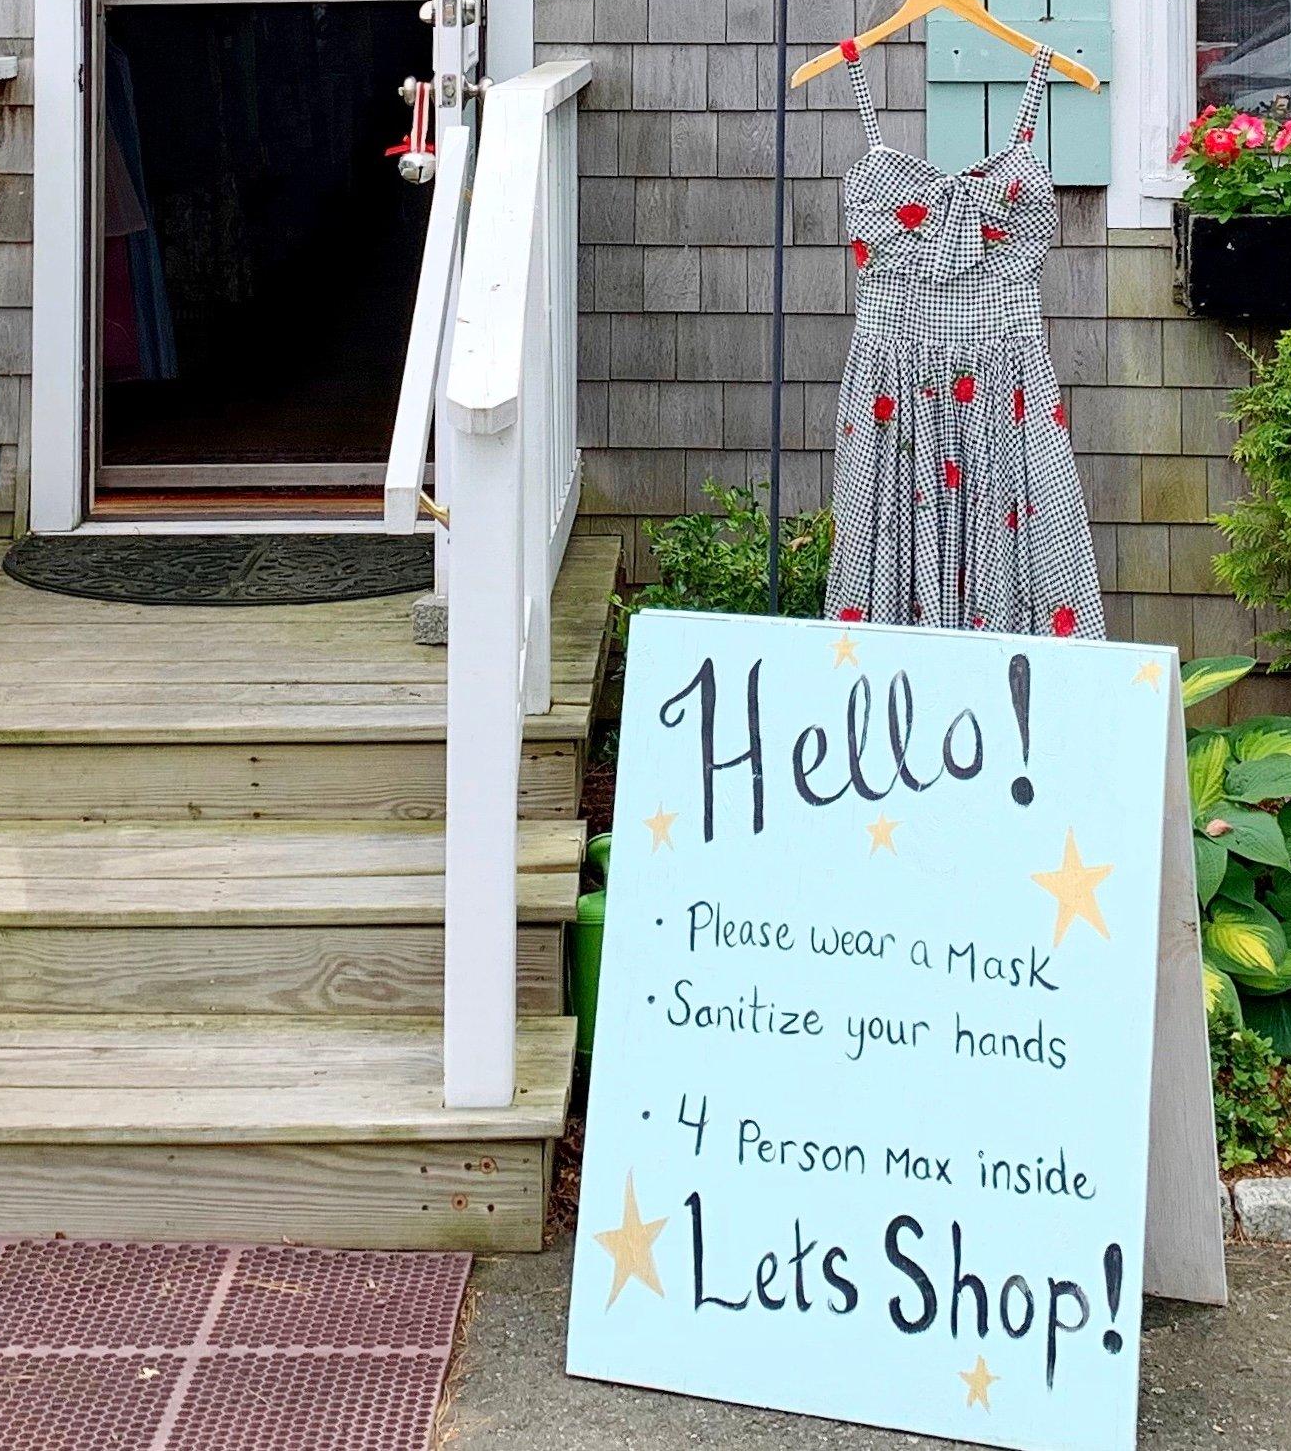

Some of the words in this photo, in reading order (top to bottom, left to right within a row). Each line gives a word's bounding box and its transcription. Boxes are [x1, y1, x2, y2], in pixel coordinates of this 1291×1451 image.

[659, 653, 1035, 843] Hello!
[687, 900, 795, 952] Please
[811, 926, 896, 959] wear
[911, 939, 933, 969] a
[948, 942, 1060, 991] Mask
[667, 979, 824, 1036] Sanitize
[845, 1015, 931, 1061] your
[955, 1012, 1067, 1069] hands
[678, 1093, 710, 1156] 4
[738, 1119, 865, 1175] Person
[886, 1147, 953, 1186] Max
[979, 1147, 1096, 1200] inside
[684, 1191, 860, 1315] Lets
[884, 1214, 1125, 1392] Shop!
